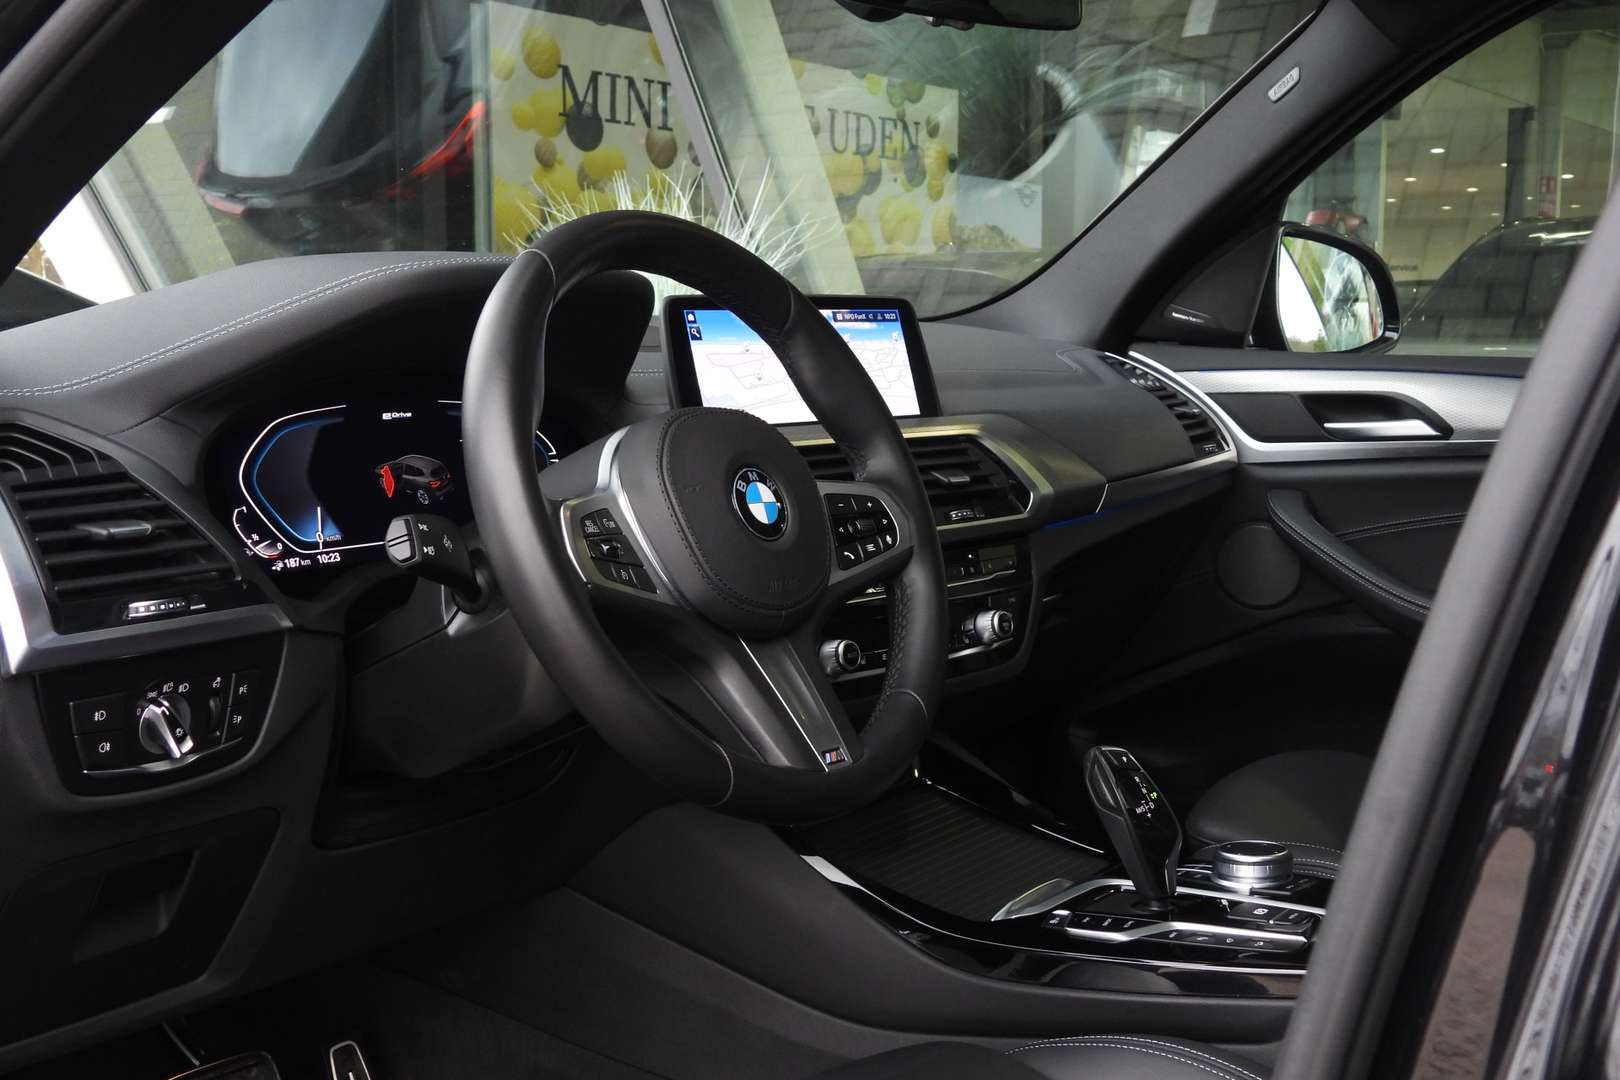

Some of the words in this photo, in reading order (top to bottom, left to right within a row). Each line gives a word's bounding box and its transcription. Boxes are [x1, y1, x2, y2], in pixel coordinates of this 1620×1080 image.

[557, 64, 673, 131] MINI
[827, 108, 921, 161] UDEN
[736, 471, 776, 493] BMW
[284, 557, 300, 568] 187
[300, 558, 311, 566] km
[317, 552, 340, 564] 10:23
